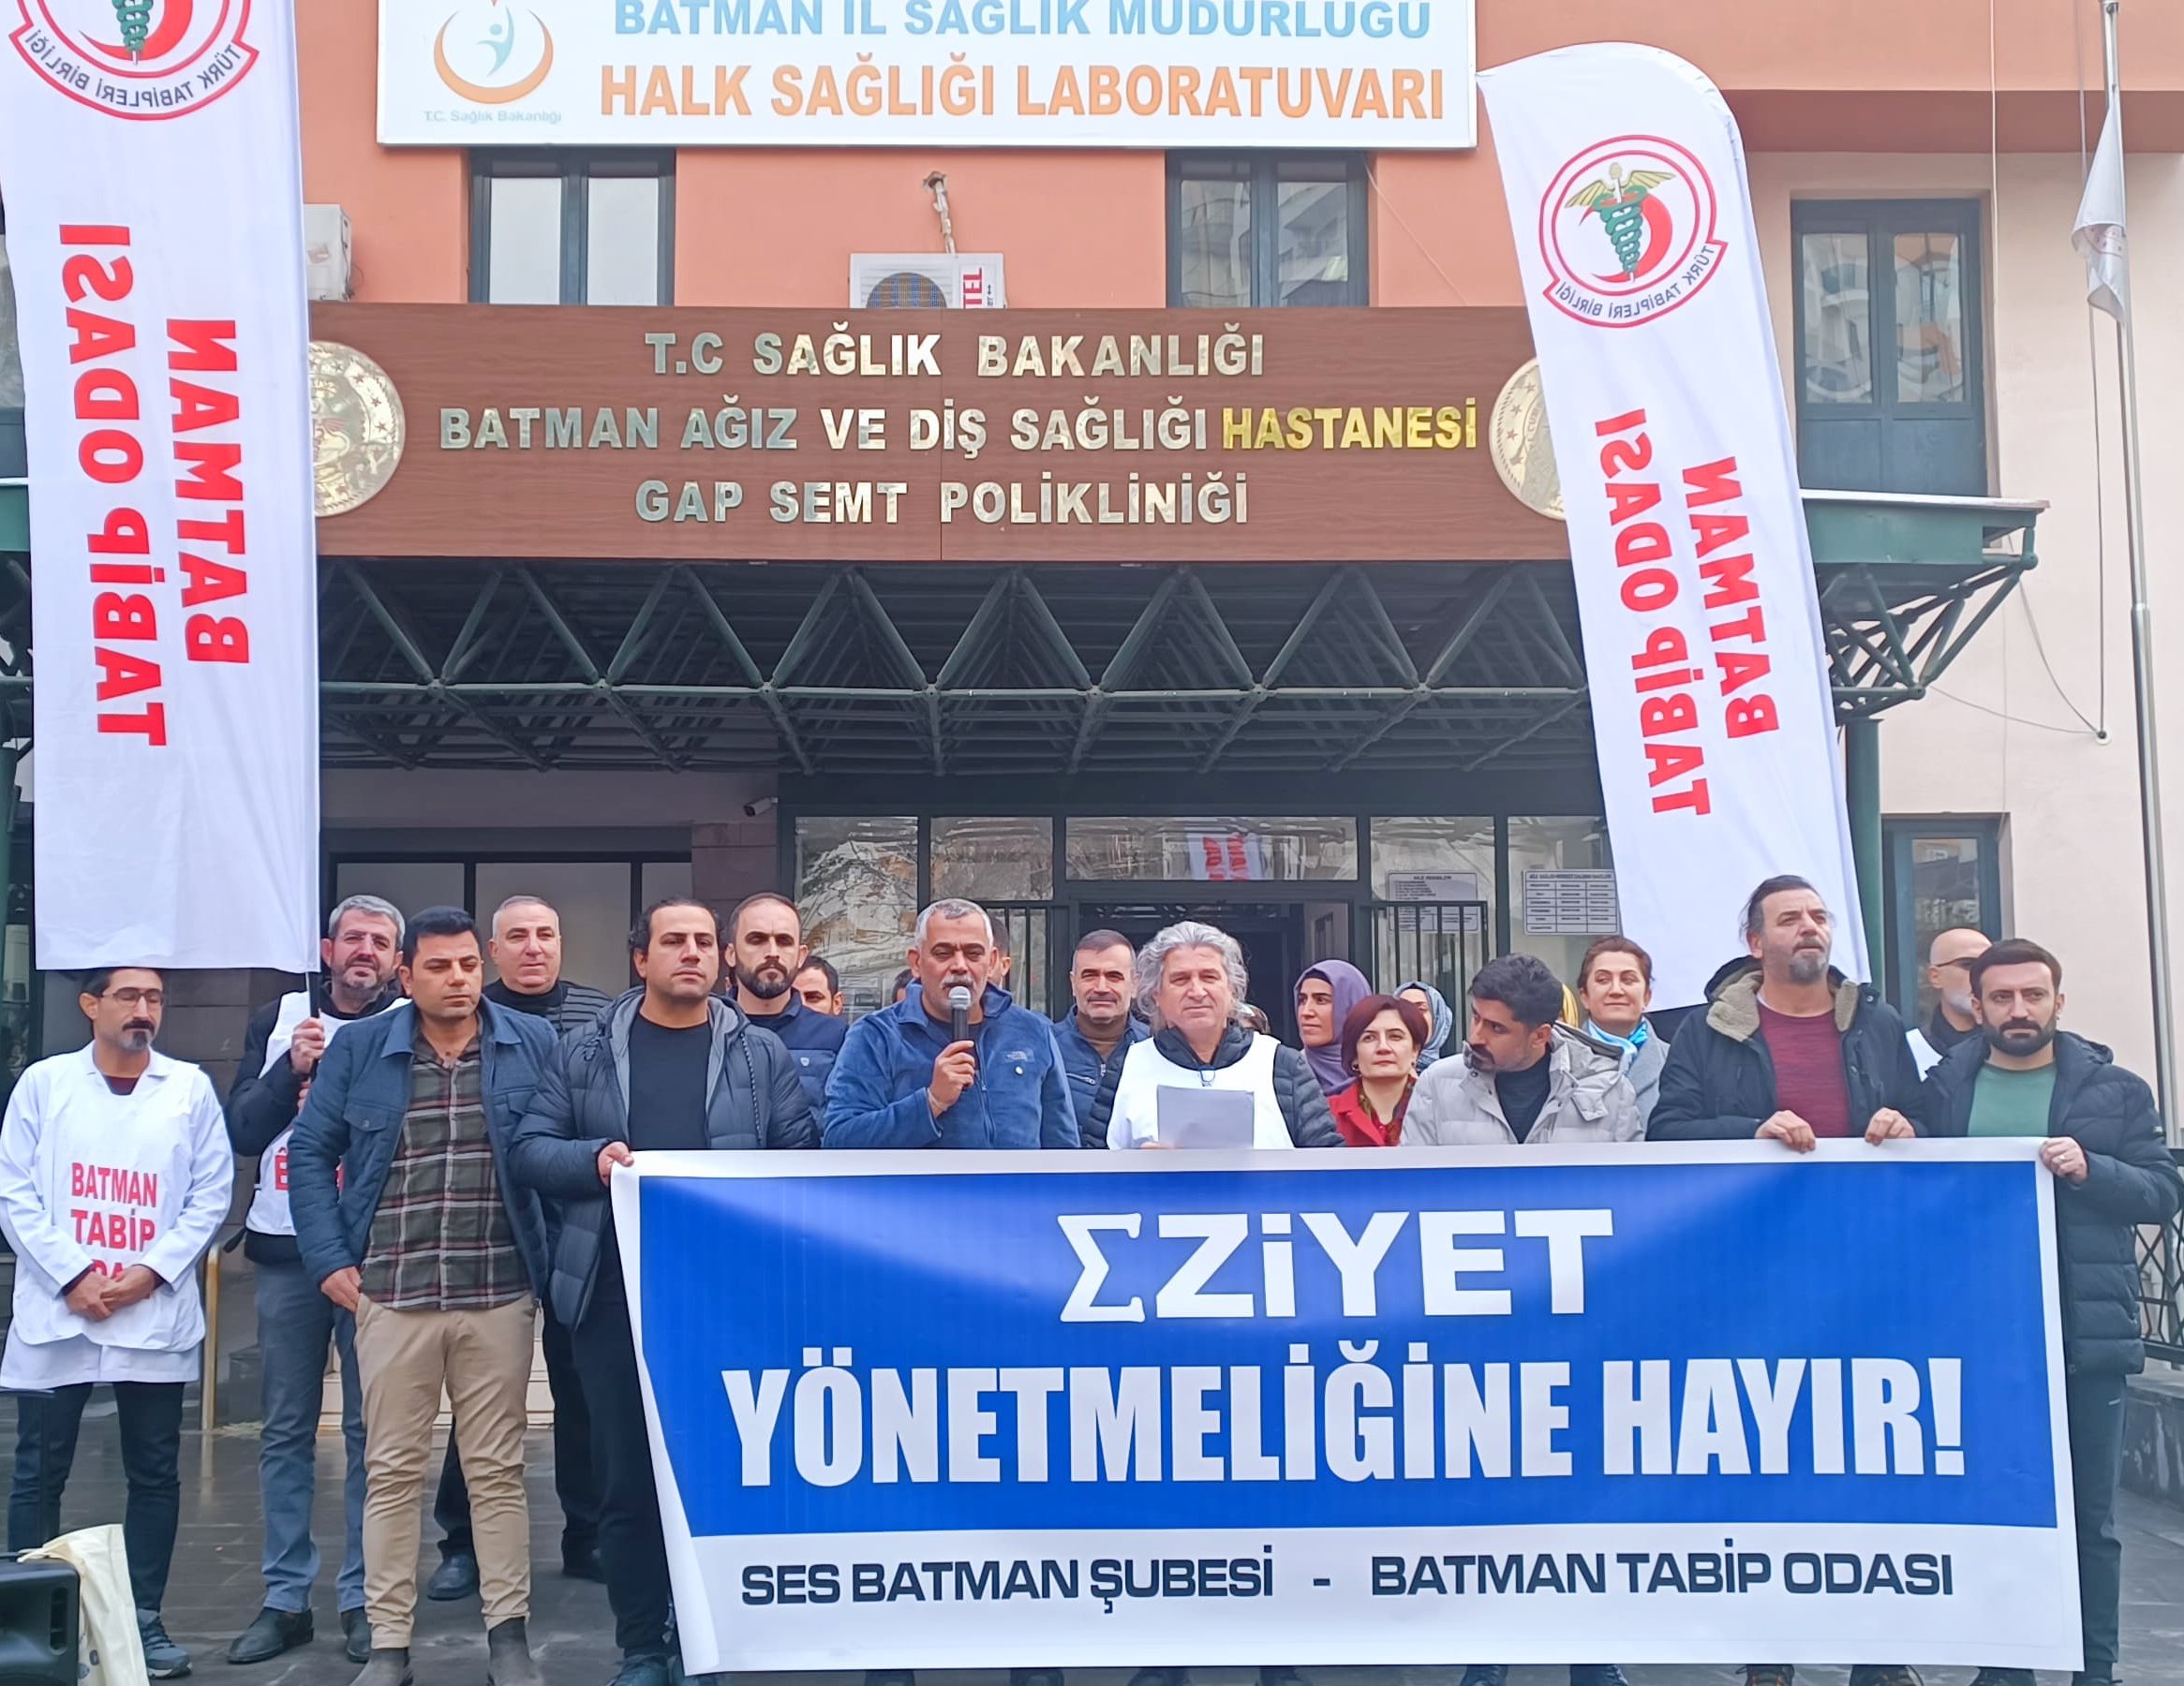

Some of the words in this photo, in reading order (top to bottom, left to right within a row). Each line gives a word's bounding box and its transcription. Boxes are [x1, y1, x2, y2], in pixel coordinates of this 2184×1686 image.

[615, 0, 823, 36] BATMAN
[601, 65, 753, 116] HALK
[771, 52, 995, 118] SAĞLIĞI
[1017, 64, 1444, 120] LABORATUVARI
[450, 110, 493, 125] Sağlık
[498, 110, 562, 125] Bakanlığı
[645, 332, 723, 376] T.C
[753, 321, 942, 377] SAĞLIK
[977, 322, 1264, 377] BAKANLIĞI
[439, 407, 658, 451] BATMAN
[680, 394, 797, 451] AĞIZ
[821, 407, 886, 451] VE
[910, 398, 987, 460] DİŞ
[1010, 395, 1208, 452] SAĞLIĞI
[1222, 397, 1478, 451] HASTANESİ
[635, 480, 743, 524] GAP
[769, 481, 907, 525] SEMT
[940, 472, 1248, 525] POLİKLİNİĞİ
[70, 1161, 157, 1208] BATMAN
[69, 1207, 156, 1252] TABİP
[721, 1340, 1574, 1487] YÖNETMELİĞİNE
[1602, 1357, 1967, 1478] HAYIR!
[741, 1564, 840, 1605] SES
[852, 1559, 1079, 1603] BATMAN
[1090, 1545, 1274, 1614] ŞUBESİ
[1371, 1551, 1607, 1597] BATMAN
[1616, 1537, 1773, 1594] TABİP
[1783, 1551, 1954, 1596] ODASI
